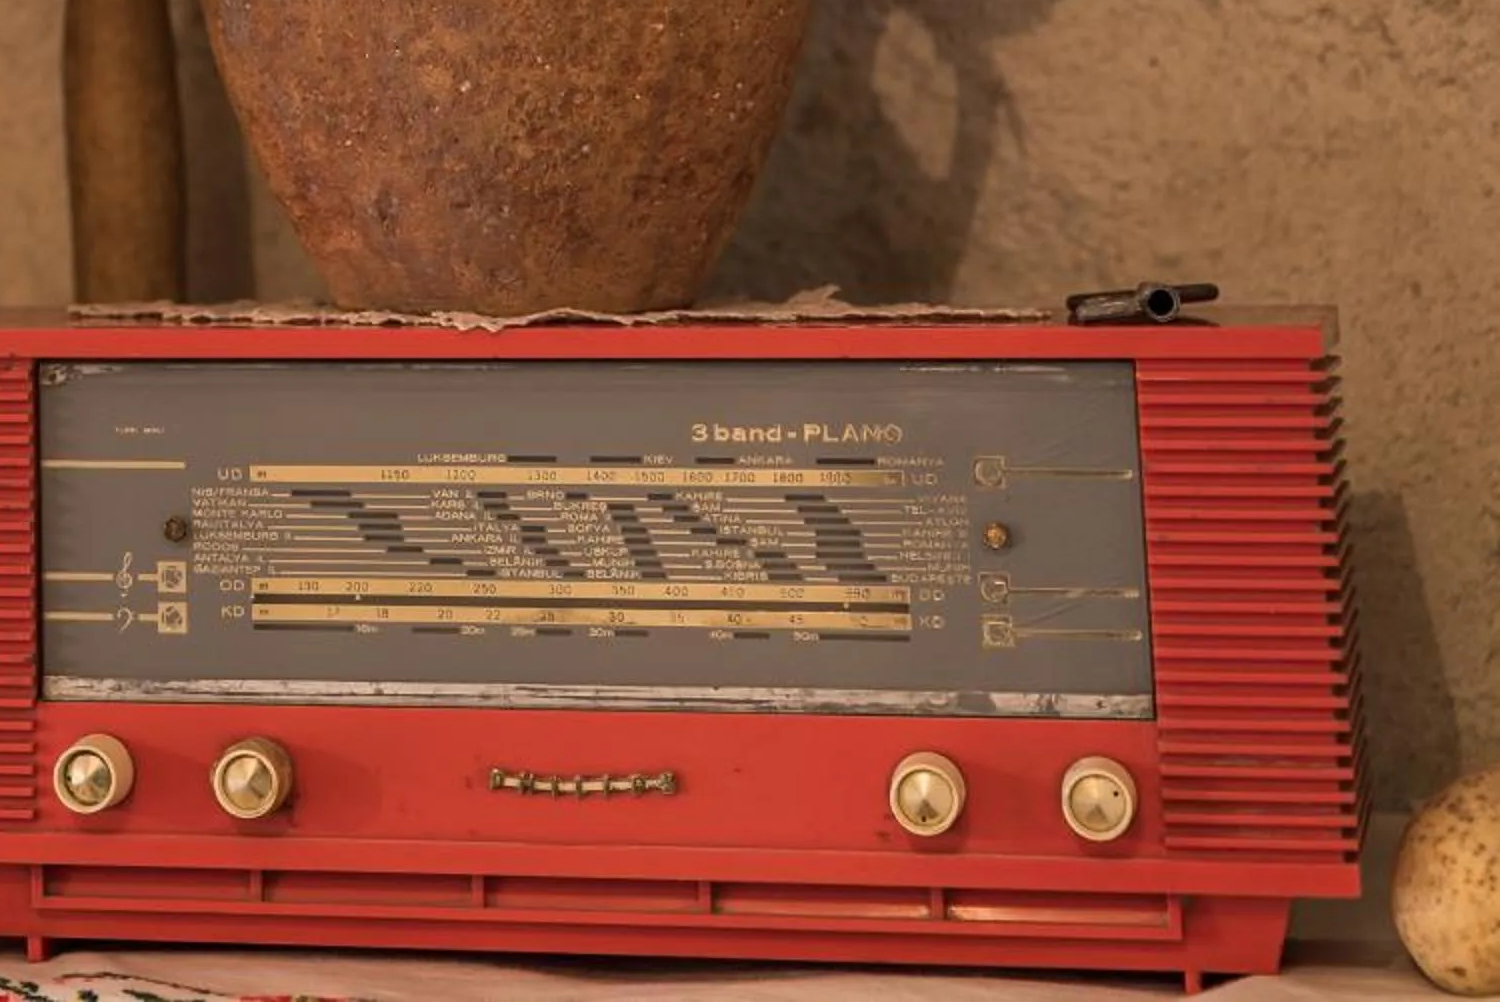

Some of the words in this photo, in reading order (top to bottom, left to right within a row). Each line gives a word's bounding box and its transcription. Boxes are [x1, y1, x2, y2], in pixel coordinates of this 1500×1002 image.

[217, 468, 243, 480] UD
[432, 489, 460, 499] VAN
[451, 533, 504, 543] ANKARA
[219, 579, 245, 591] OD
[346, 581, 369, 592] 200
[409, 582, 433, 593] 220
[474, 583, 497, 594] 250
[665, 585, 689, 596] 400
[220, 605, 245, 618] KD
[485, 609, 501, 620] 22
[609, 612, 625, 623] 30
